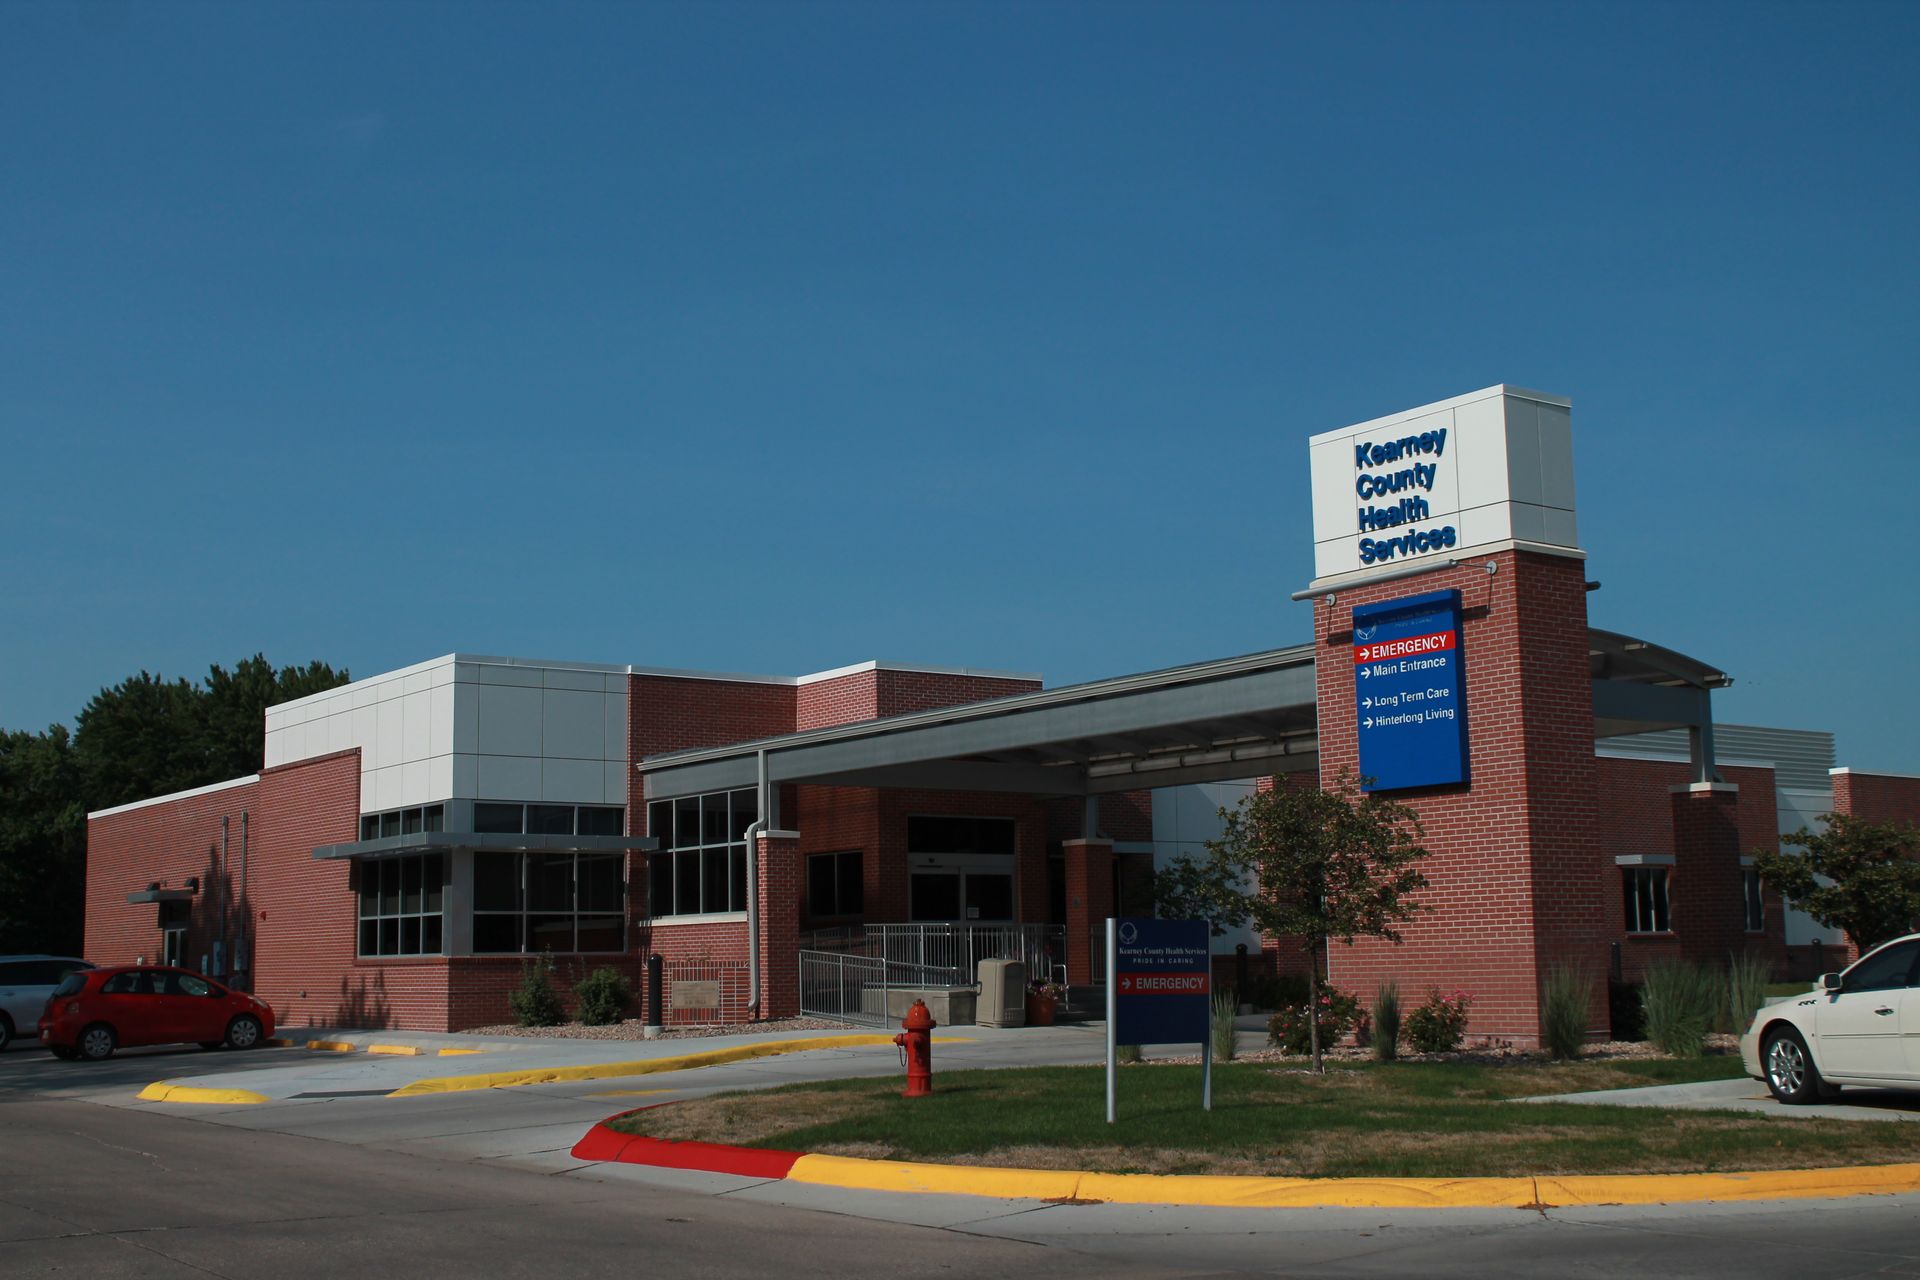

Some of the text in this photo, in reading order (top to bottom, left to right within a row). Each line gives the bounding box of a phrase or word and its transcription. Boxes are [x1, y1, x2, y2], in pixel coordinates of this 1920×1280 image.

[1355, 428, 1447, 470] Kearney
[1356, 462, 1437, 501] County
[1358, 495, 1429, 533] Health
[1359, 526, 1456, 565] Services
[1372, 635, 1447, 659] EMERGENCY
[1373, 657, 1446, 677] Main Entrance
[1374, 688, 1449, 707] Long Term Care
[1375, 708, 1454, 727] Hinterlong Living
[1144, 947, 1164, 956] County
[1136, 978, 1204, 989] EMERGENCY
